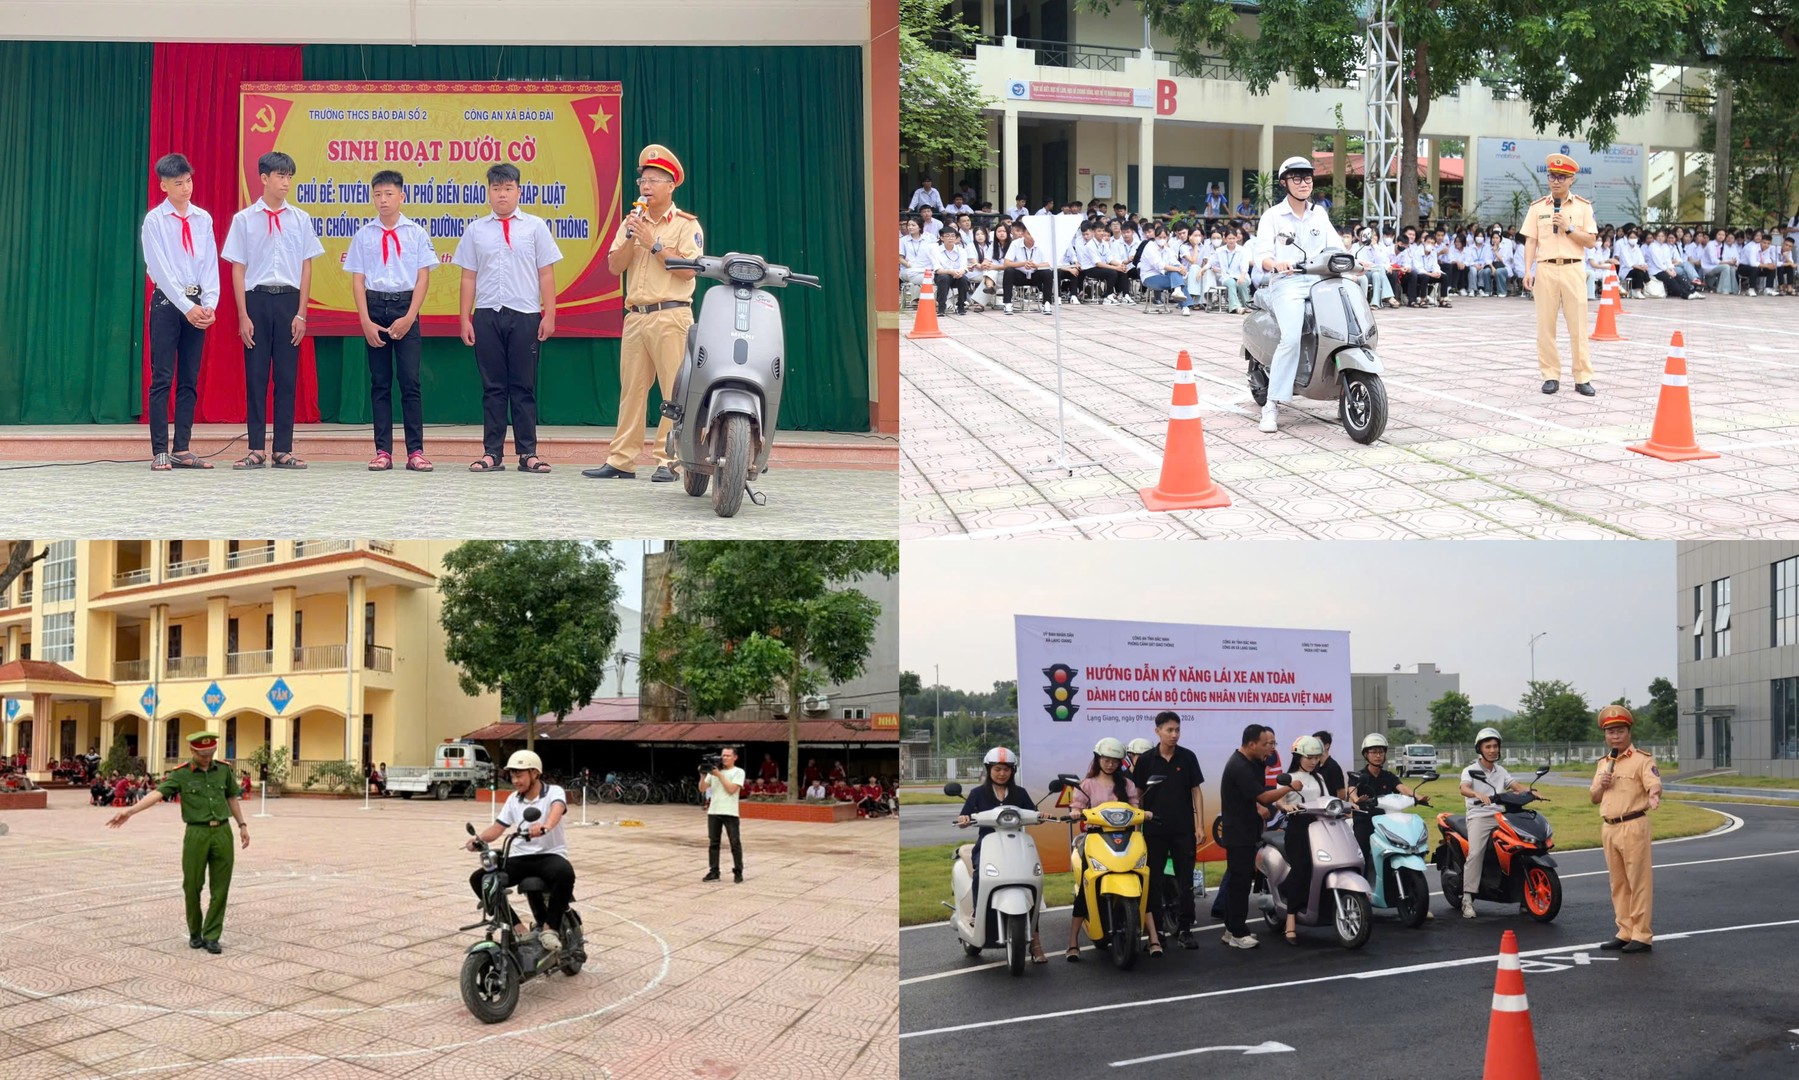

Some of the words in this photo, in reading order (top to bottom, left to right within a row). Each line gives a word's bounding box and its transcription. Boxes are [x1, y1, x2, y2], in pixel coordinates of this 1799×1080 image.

[1156, 80, 1177, 115] B
[309, 108, 344, 120] TRƯỜNG
[347, 110, 370, 120] THCS
[372, 106, 390, 120] BẢO
[392, 108, 406, 120] ĐÀI
[408, 106, 420, 120] SỐ
[422, 110, 428, 120] 2
[464, 108, 488, 120] CÔNG
[492, 110, 503, 120] AN
[506, 108, 516, 120] XÃ
[520, 108, 538, 120] BẢO
[540, 108, 554, 120] ĐÀI
[328, 140, 379, 161] SINH
[384, 140, 443, 168] HOẠT
[448, 134, 502, 162] DƯỚI
[507, 135, 536, 162] CỜ
[1501, 141, 1516, 152] 5G
[296, 178, 317, 204] CHỦ
[320, 178, 336, 204] ĐỀ:
[338, 180, 370, 204] TUYÊN
[414, 177, 434, 204] PHỔ
[437, 178, 459, 204] BIẾN
[463, 181, 486, 204] GIÁO
[519, 181, 538, 204] HÁP
[542, 181, 566, 208] LUẬT
[326, 210, 360, 236] CHỐNG
[430, 213, 464, 237] ĐƯỜNG
[556, 214, 588, 238] THÔNG
[1086, 664, 1132, 681] HƯỚNG
[1135, 663, 1160, 682] DẪN
[1162, 666, 1176, 682] KỸ
[1179, 666, 1212, 683] NĂNG
[1214, 667, 1231, 683] LÁI
[1234, 671, 1247, 683] XE
[1249, 671, 1264, 684] AN
[1266, 668, 1295, 684] TOÀN
[1087, 686, 1116, 701] DÀNH
[1119, 690, 1140, 702] CHO
[1142, 687, 1162, 702] CÁN
[1165, 688, 1178, 705] BỘ
[1180, 688, 1206, 703] CÔNG
[1209, 689, 1236, 703] NHÂN
[1237, 689, 1259, 703] VIÊN
[1261, 693, 1291, 704] YADEA
[1292, 690, 1311, 706] VIỆT
[1313, 693, 1332, 704] NAM
[1087, 714, 1102, 722] Lạng
